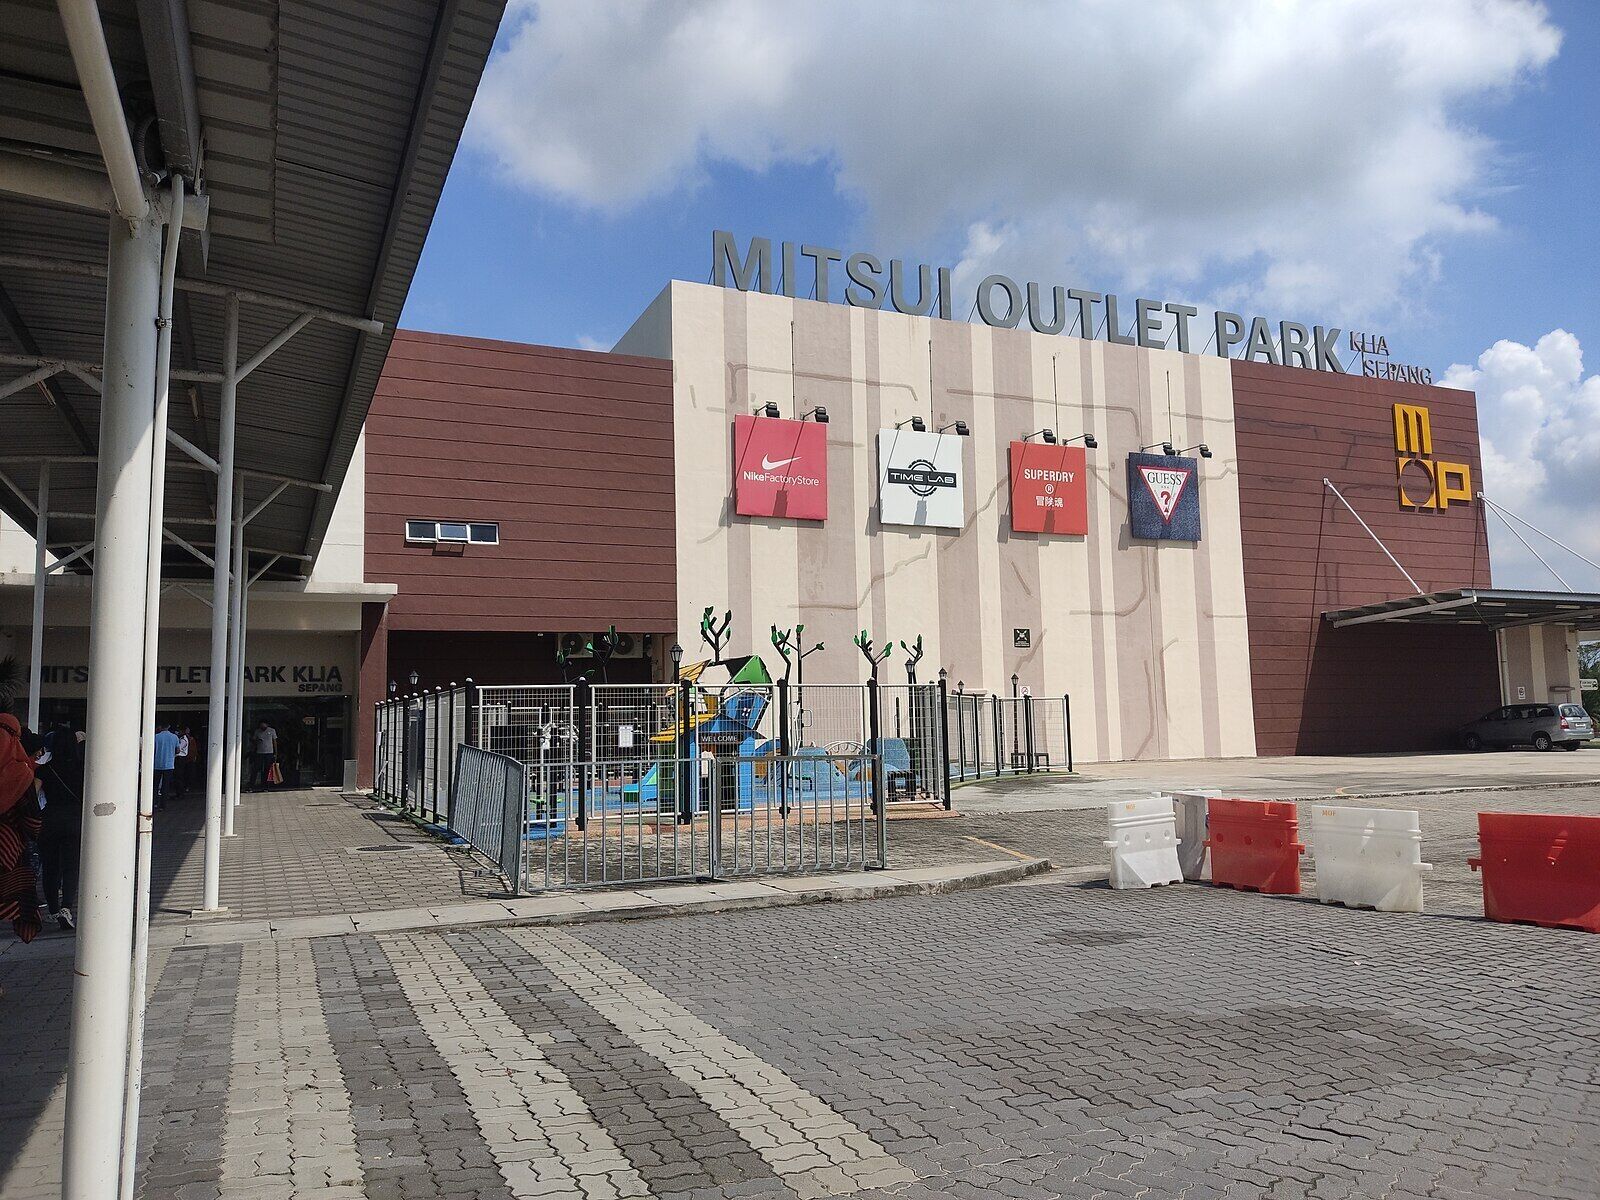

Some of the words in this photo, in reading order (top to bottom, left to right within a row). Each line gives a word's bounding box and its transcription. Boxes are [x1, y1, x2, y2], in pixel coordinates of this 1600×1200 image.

[713, 229, 952, 320] MITSUI
[976, 274, 1198, 354] OUTLET
[1214, 311, 1346, 374] PARK
[1363, 359, 1433, 385] SEPANG
[890, 472, 924, 482] TIME
[927, 475, 955, 484] LAB
[1024, 468, 1075, 483] SUPERDRY
[1147, 472, 1182, 486] GUESS
[292, 665, 343, 683] KLIA
[298, 683, 343, 693] SEPANG
